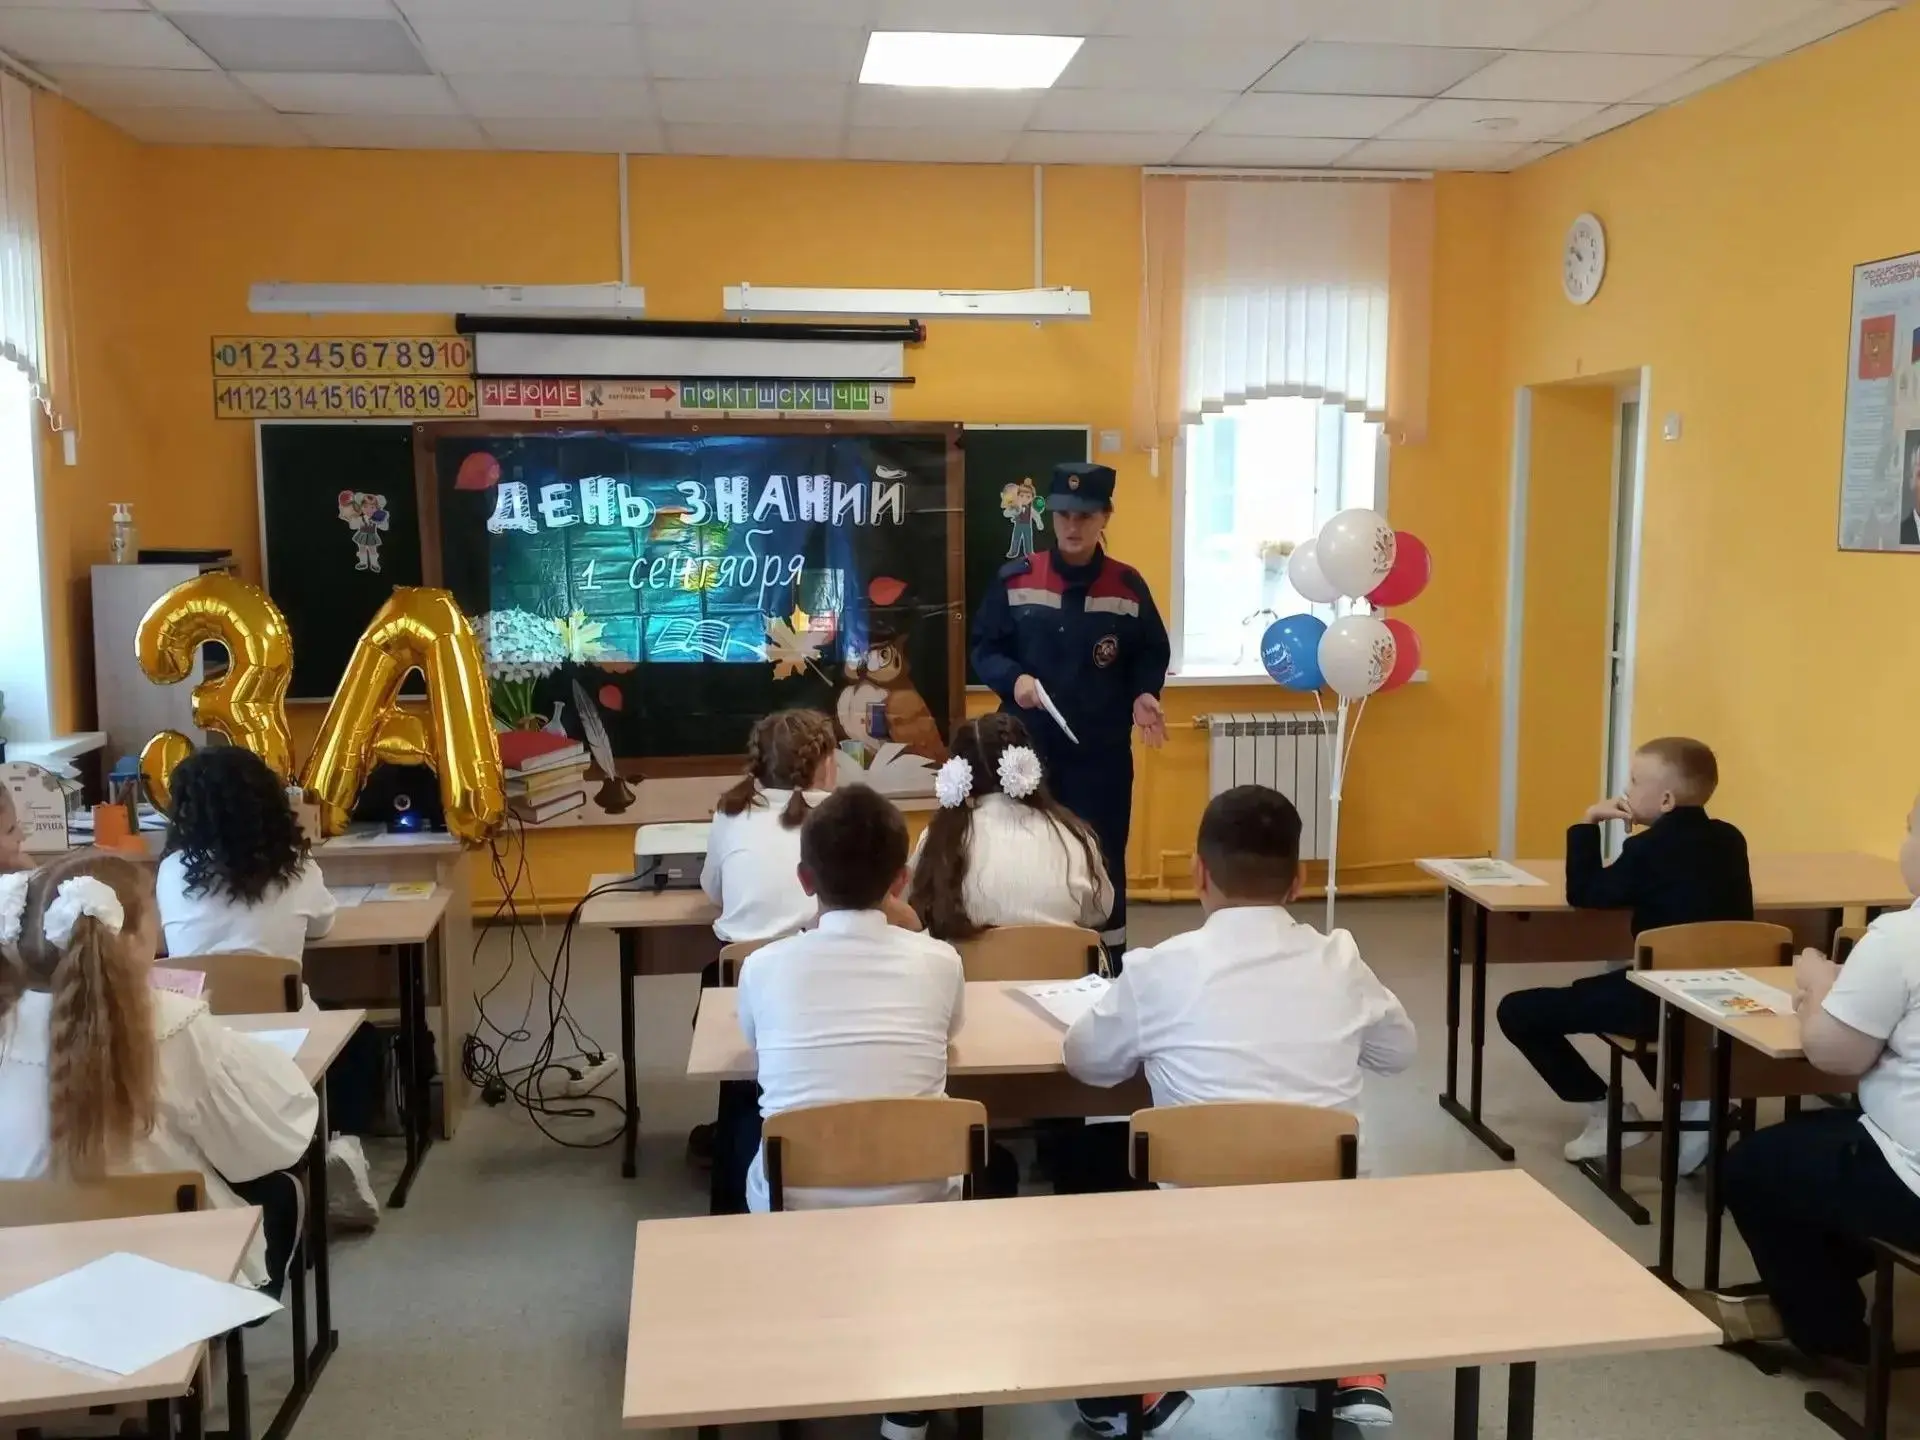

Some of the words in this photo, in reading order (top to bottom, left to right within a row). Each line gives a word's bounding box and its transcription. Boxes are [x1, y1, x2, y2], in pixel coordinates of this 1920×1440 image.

[222, 344, 236, 367] 0
[240, 344, 252, 369] 1
[261, 343, 278, 369] 2
[283, 343, 300, 369] 3
[305, 343, 322, 368] 4
[329, 343, 344, 369] 5
[351, 343, 367, 369] 6
[373, 343, 389, 368] 7
[396, 343, 412, 368] 8
[418, 343, 435, 369] 9
[438, 342, 466, 368] 10
[224, 387, 242, 410] 11
[245, 386, 267, 410] 12
[270, 386, 291, 409] 13
[295, 386, 317, 409] 14
[320, 385, 342, 408] 15
[346, 385, 367, 408] 16
[370, 385, 390, 408] 17
[395, 385, 415, 408] 18
[420, 385, 440, 408] 19
[444, 385, 468, 408] 20
[487, 474, 657, 535] ДЕНЬ
[676, 464, 908, 528] ЗНАНИЙ
[578, 558, 602, 590] 1
[628, 529, 805, 609] сентября
